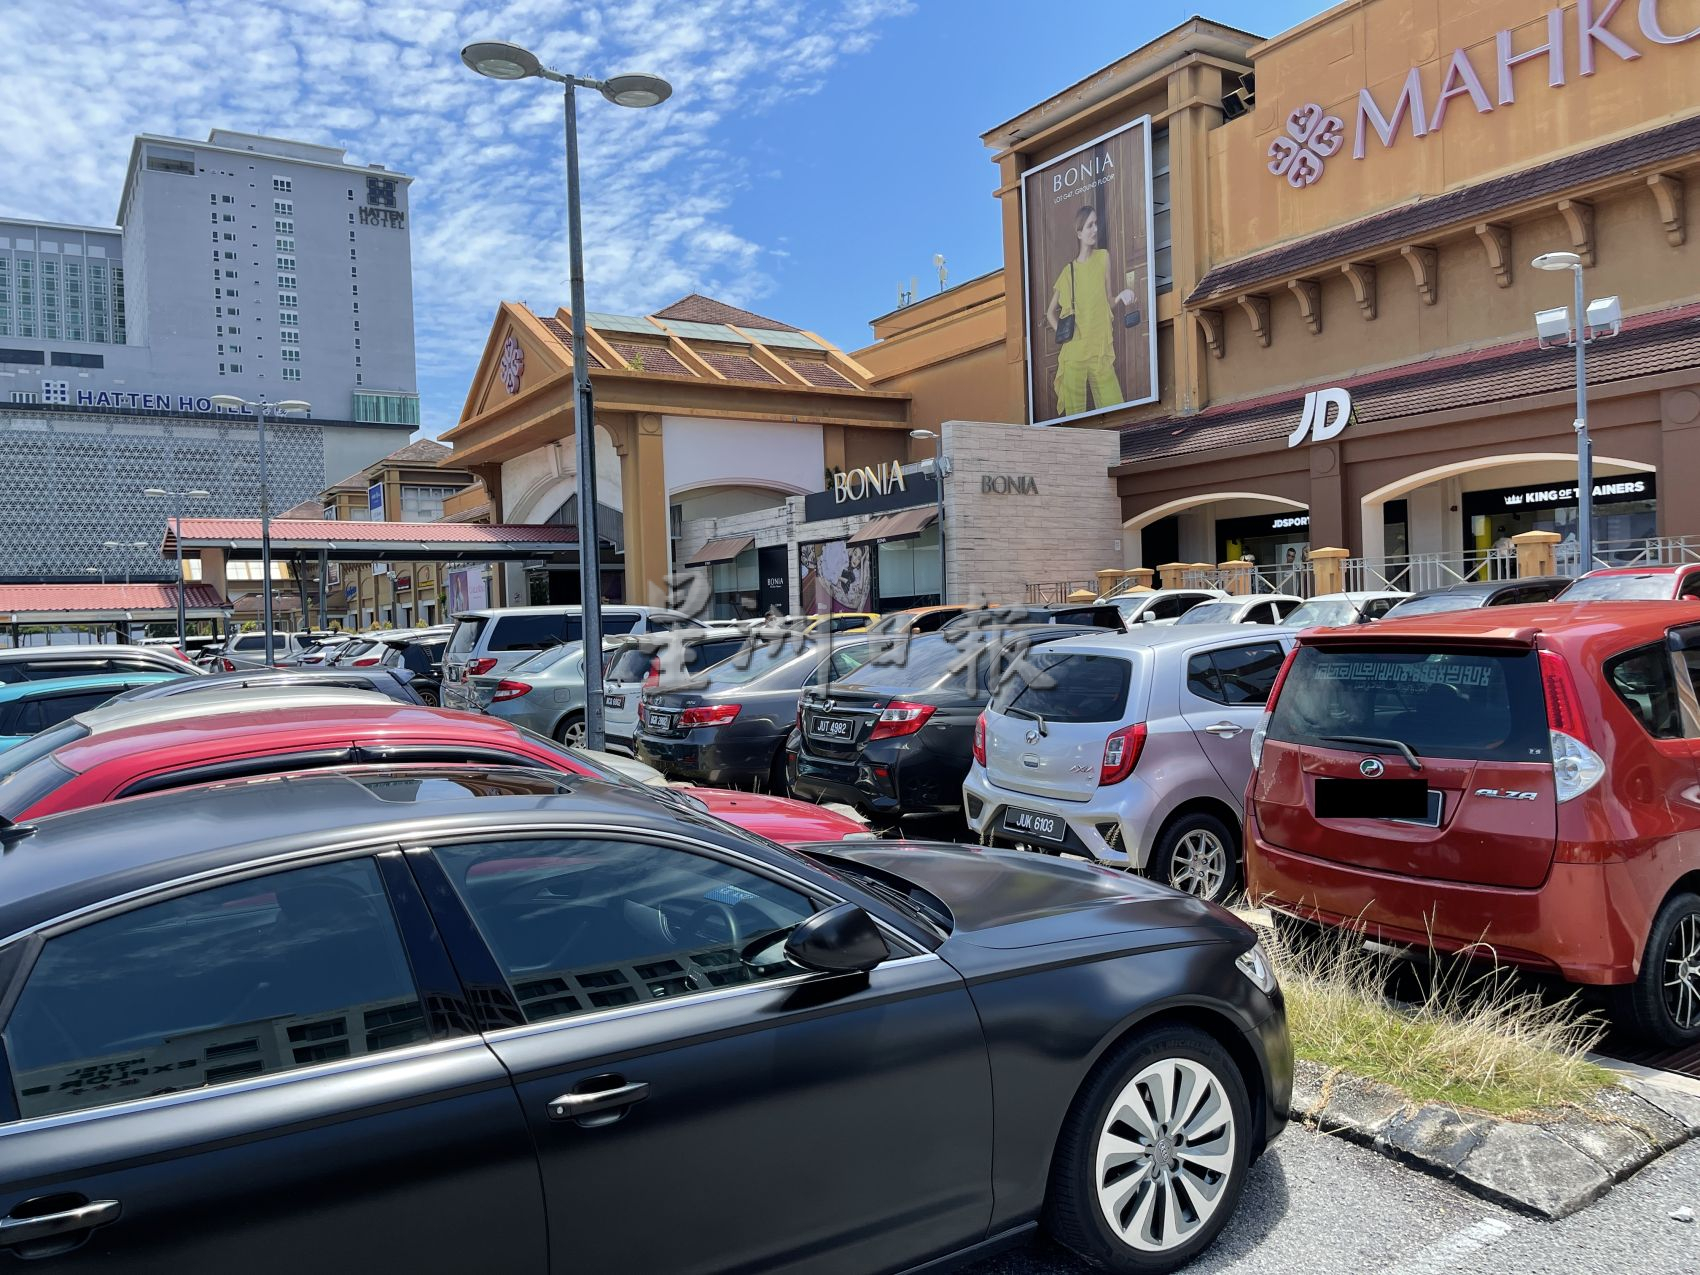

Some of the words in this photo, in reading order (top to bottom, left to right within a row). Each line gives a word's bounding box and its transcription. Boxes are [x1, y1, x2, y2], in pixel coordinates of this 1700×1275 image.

[1053, 152, 1114, 193] BONIA
[1075, 180, 1097, 195] GROUND
[1098, 173, 1115, 186] FLOOR
[359, 206, 404, 221] HATTEN
[360, 216, 405, 230] HOTEL
[77, 390, 171, 411] HATTEN
[1288, 387, 1351, 448] JD
[834, 459, 906, 504] BONIA
[981, 474, 1039, 495] BONIA
[1525, 490, 1557, 503] KING
[1558, 489, 1573, 499] OF
[1573, 481, 1645, 498] TAINERS
[1272, 516, 1310, 528] JDSPOR
[817, 720, 830, 731] JUT
[831, 722, 847, 734] 4982
[1474, 788, 1538, 800] ALZA
[1016, 813, 1032, 828] JUK
[1034, 816, 1054, 833] 6103
